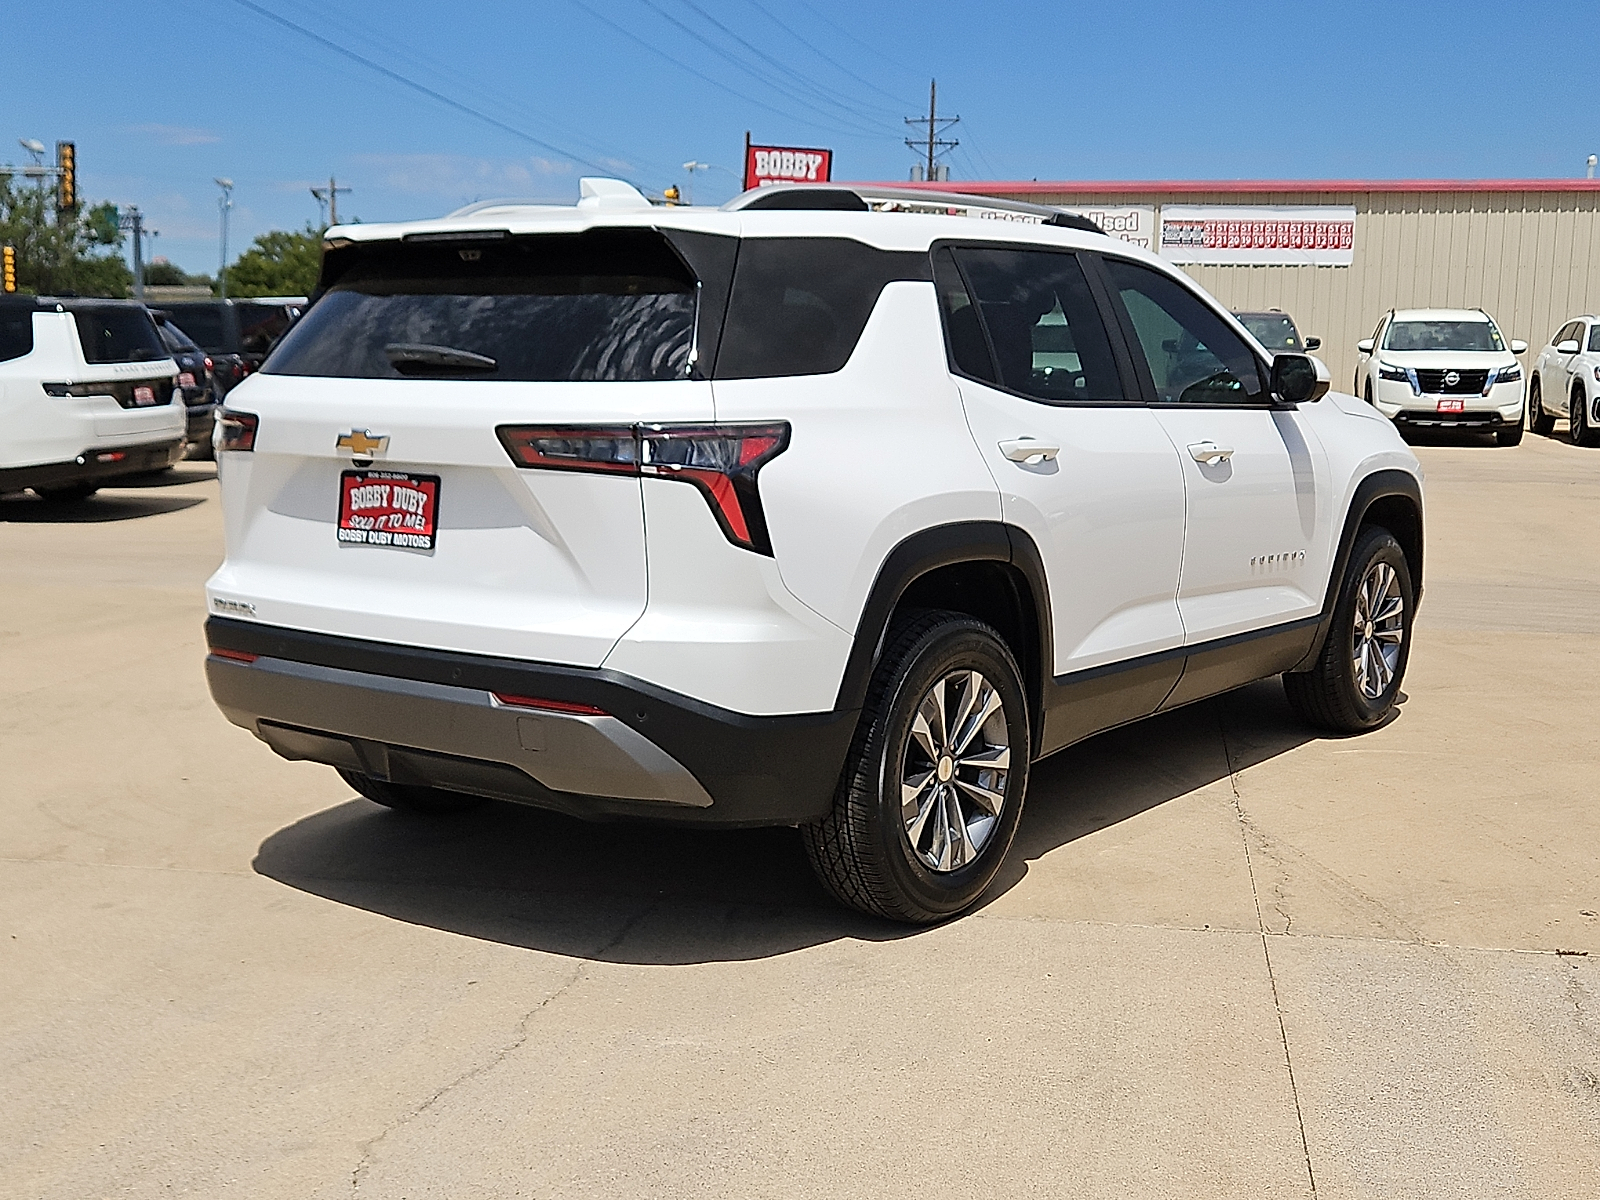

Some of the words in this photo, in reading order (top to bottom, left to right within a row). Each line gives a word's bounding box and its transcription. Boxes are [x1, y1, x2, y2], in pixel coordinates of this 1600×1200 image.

[755, 150, 822, 180] BOBBY
[1089, 212, 1139, 231] Used
[350, 485, 391, 510] BOBBY
[392, 486, 428, 515] DUBY
[348, 514, 375, 530] SOLD
[375, 515, 389, 529] IT
[388, 513, 403, 529] TO
[403, 512, 426, 531] ME!
[339, 528, 367, 542] BOBBY
[368, 531, 393, 544] DUBY
[393, 534, 431, 548] MOTORS
